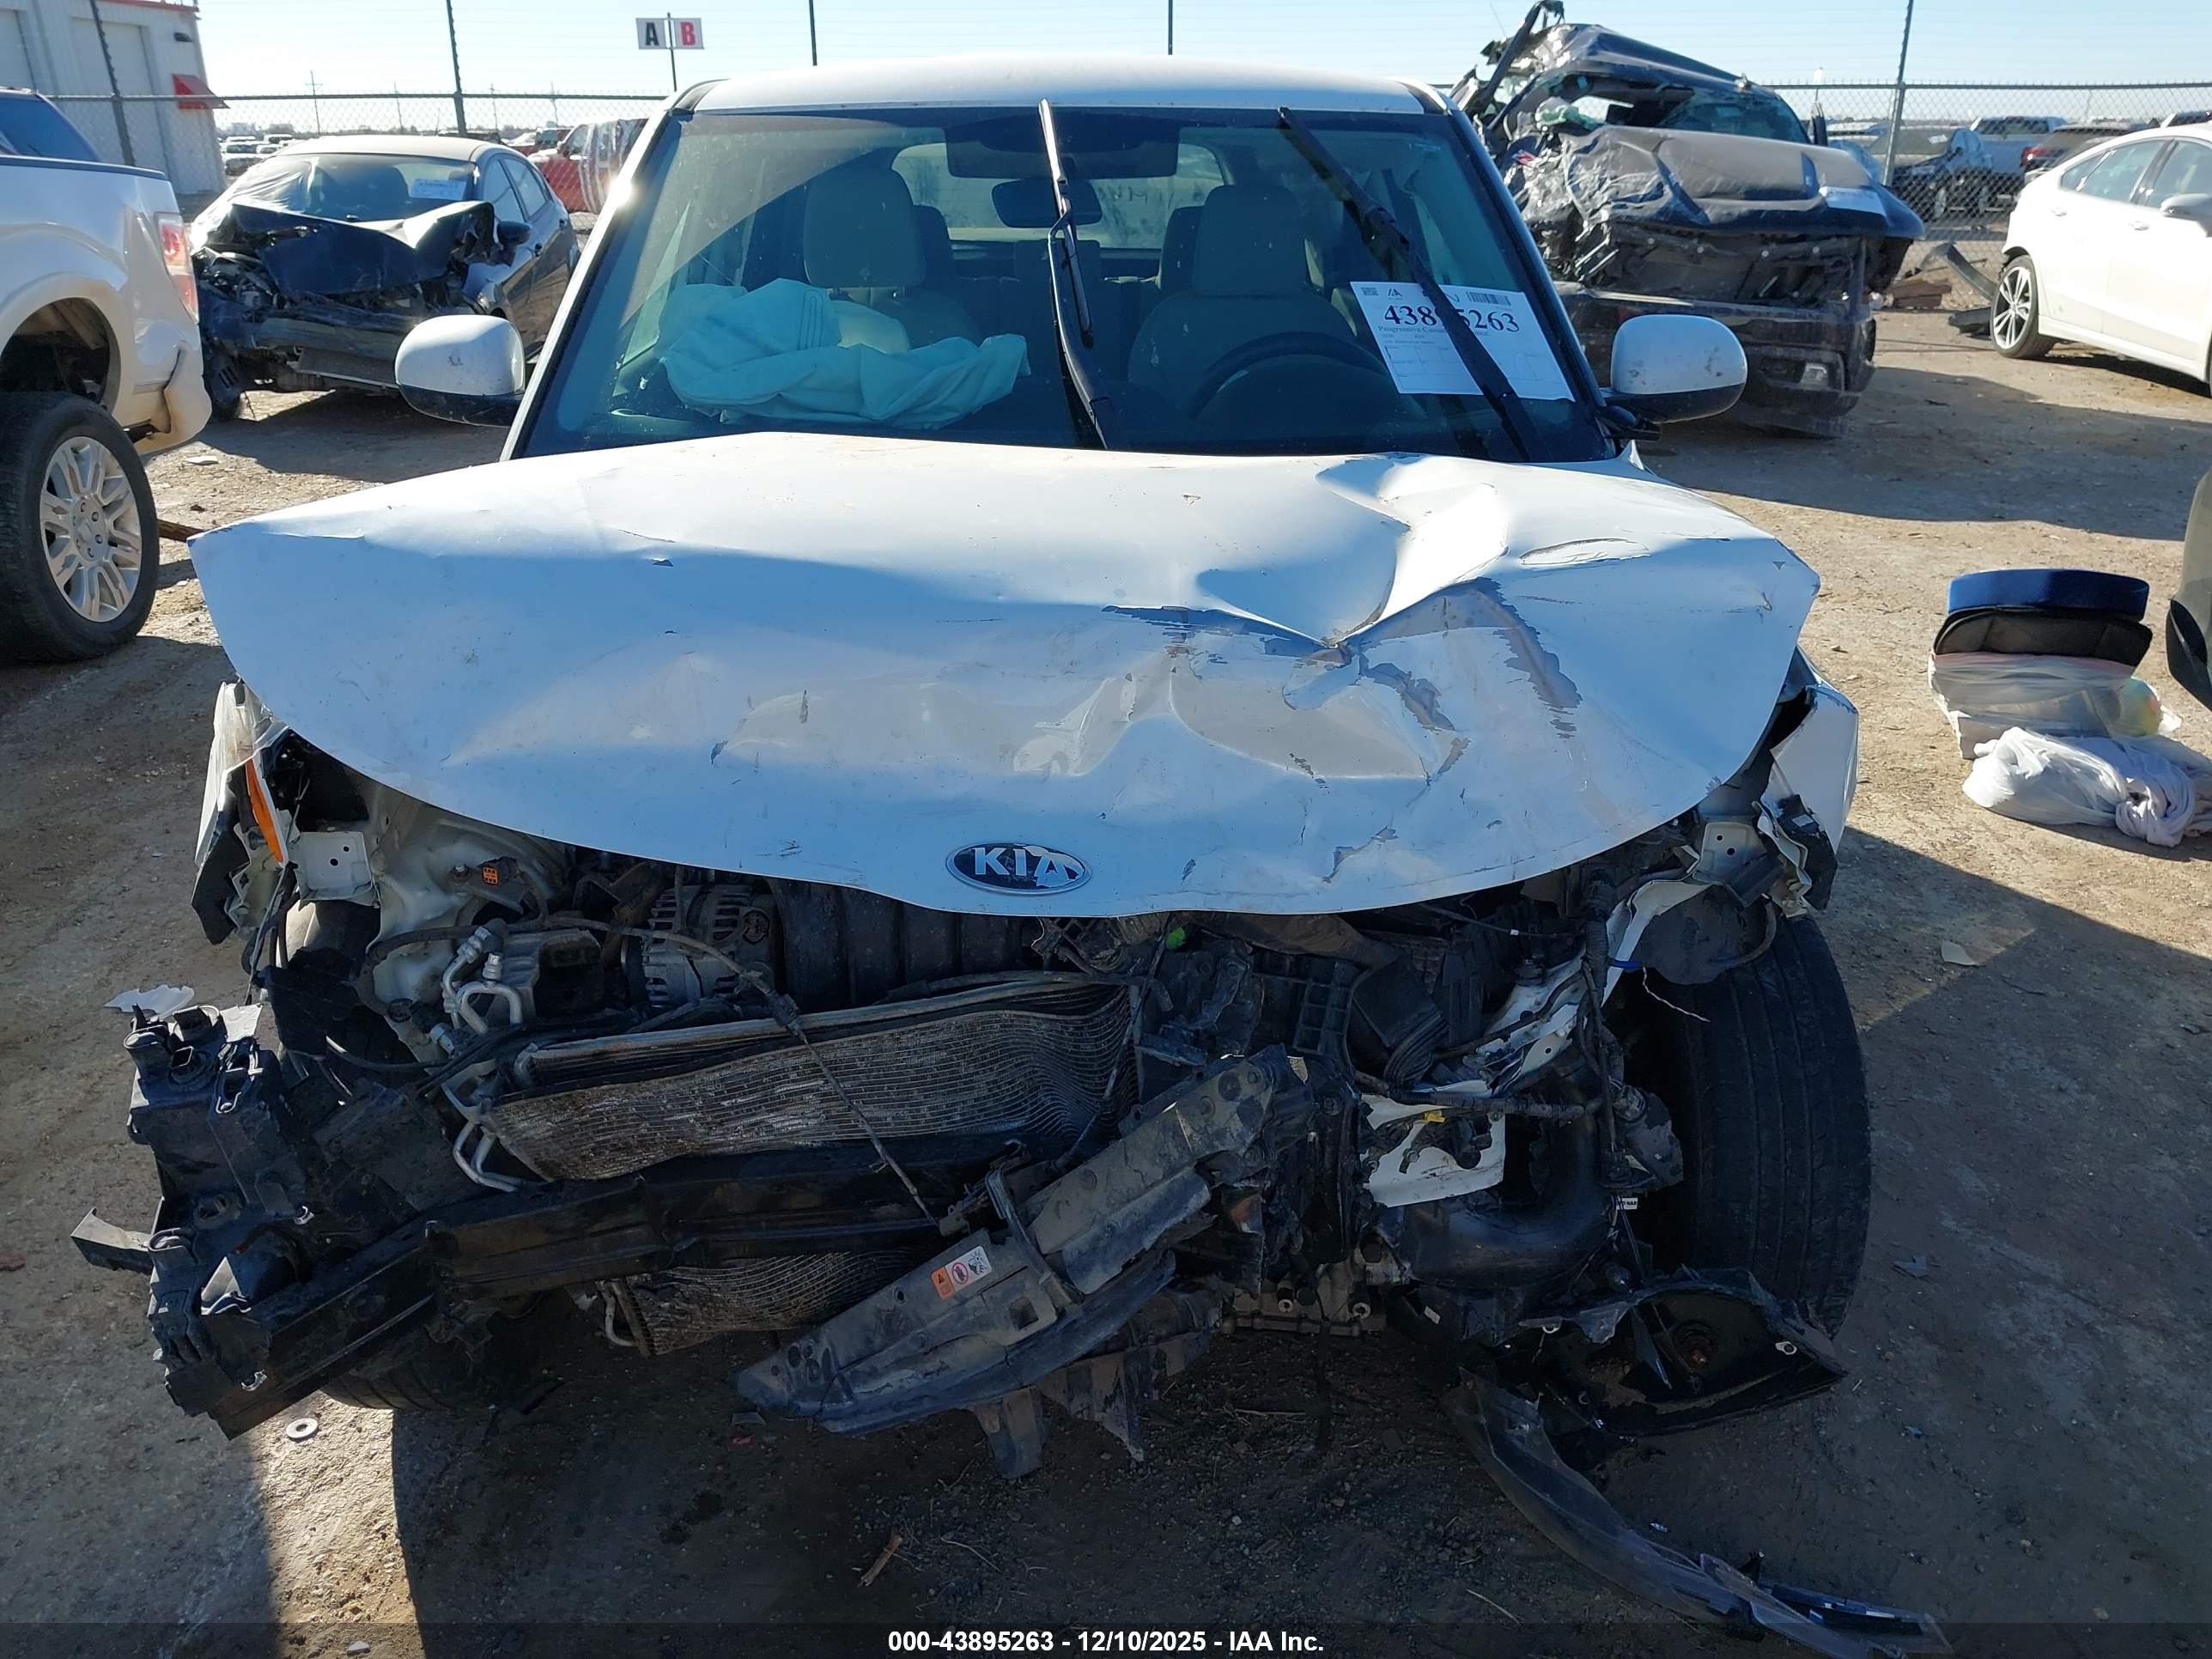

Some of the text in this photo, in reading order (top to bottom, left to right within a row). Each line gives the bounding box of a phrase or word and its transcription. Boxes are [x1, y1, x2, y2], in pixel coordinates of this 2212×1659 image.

[645, 21, 659, 46] A
[680, 21, 696, 46] B
[972, 847, 1071, 881] KIA
